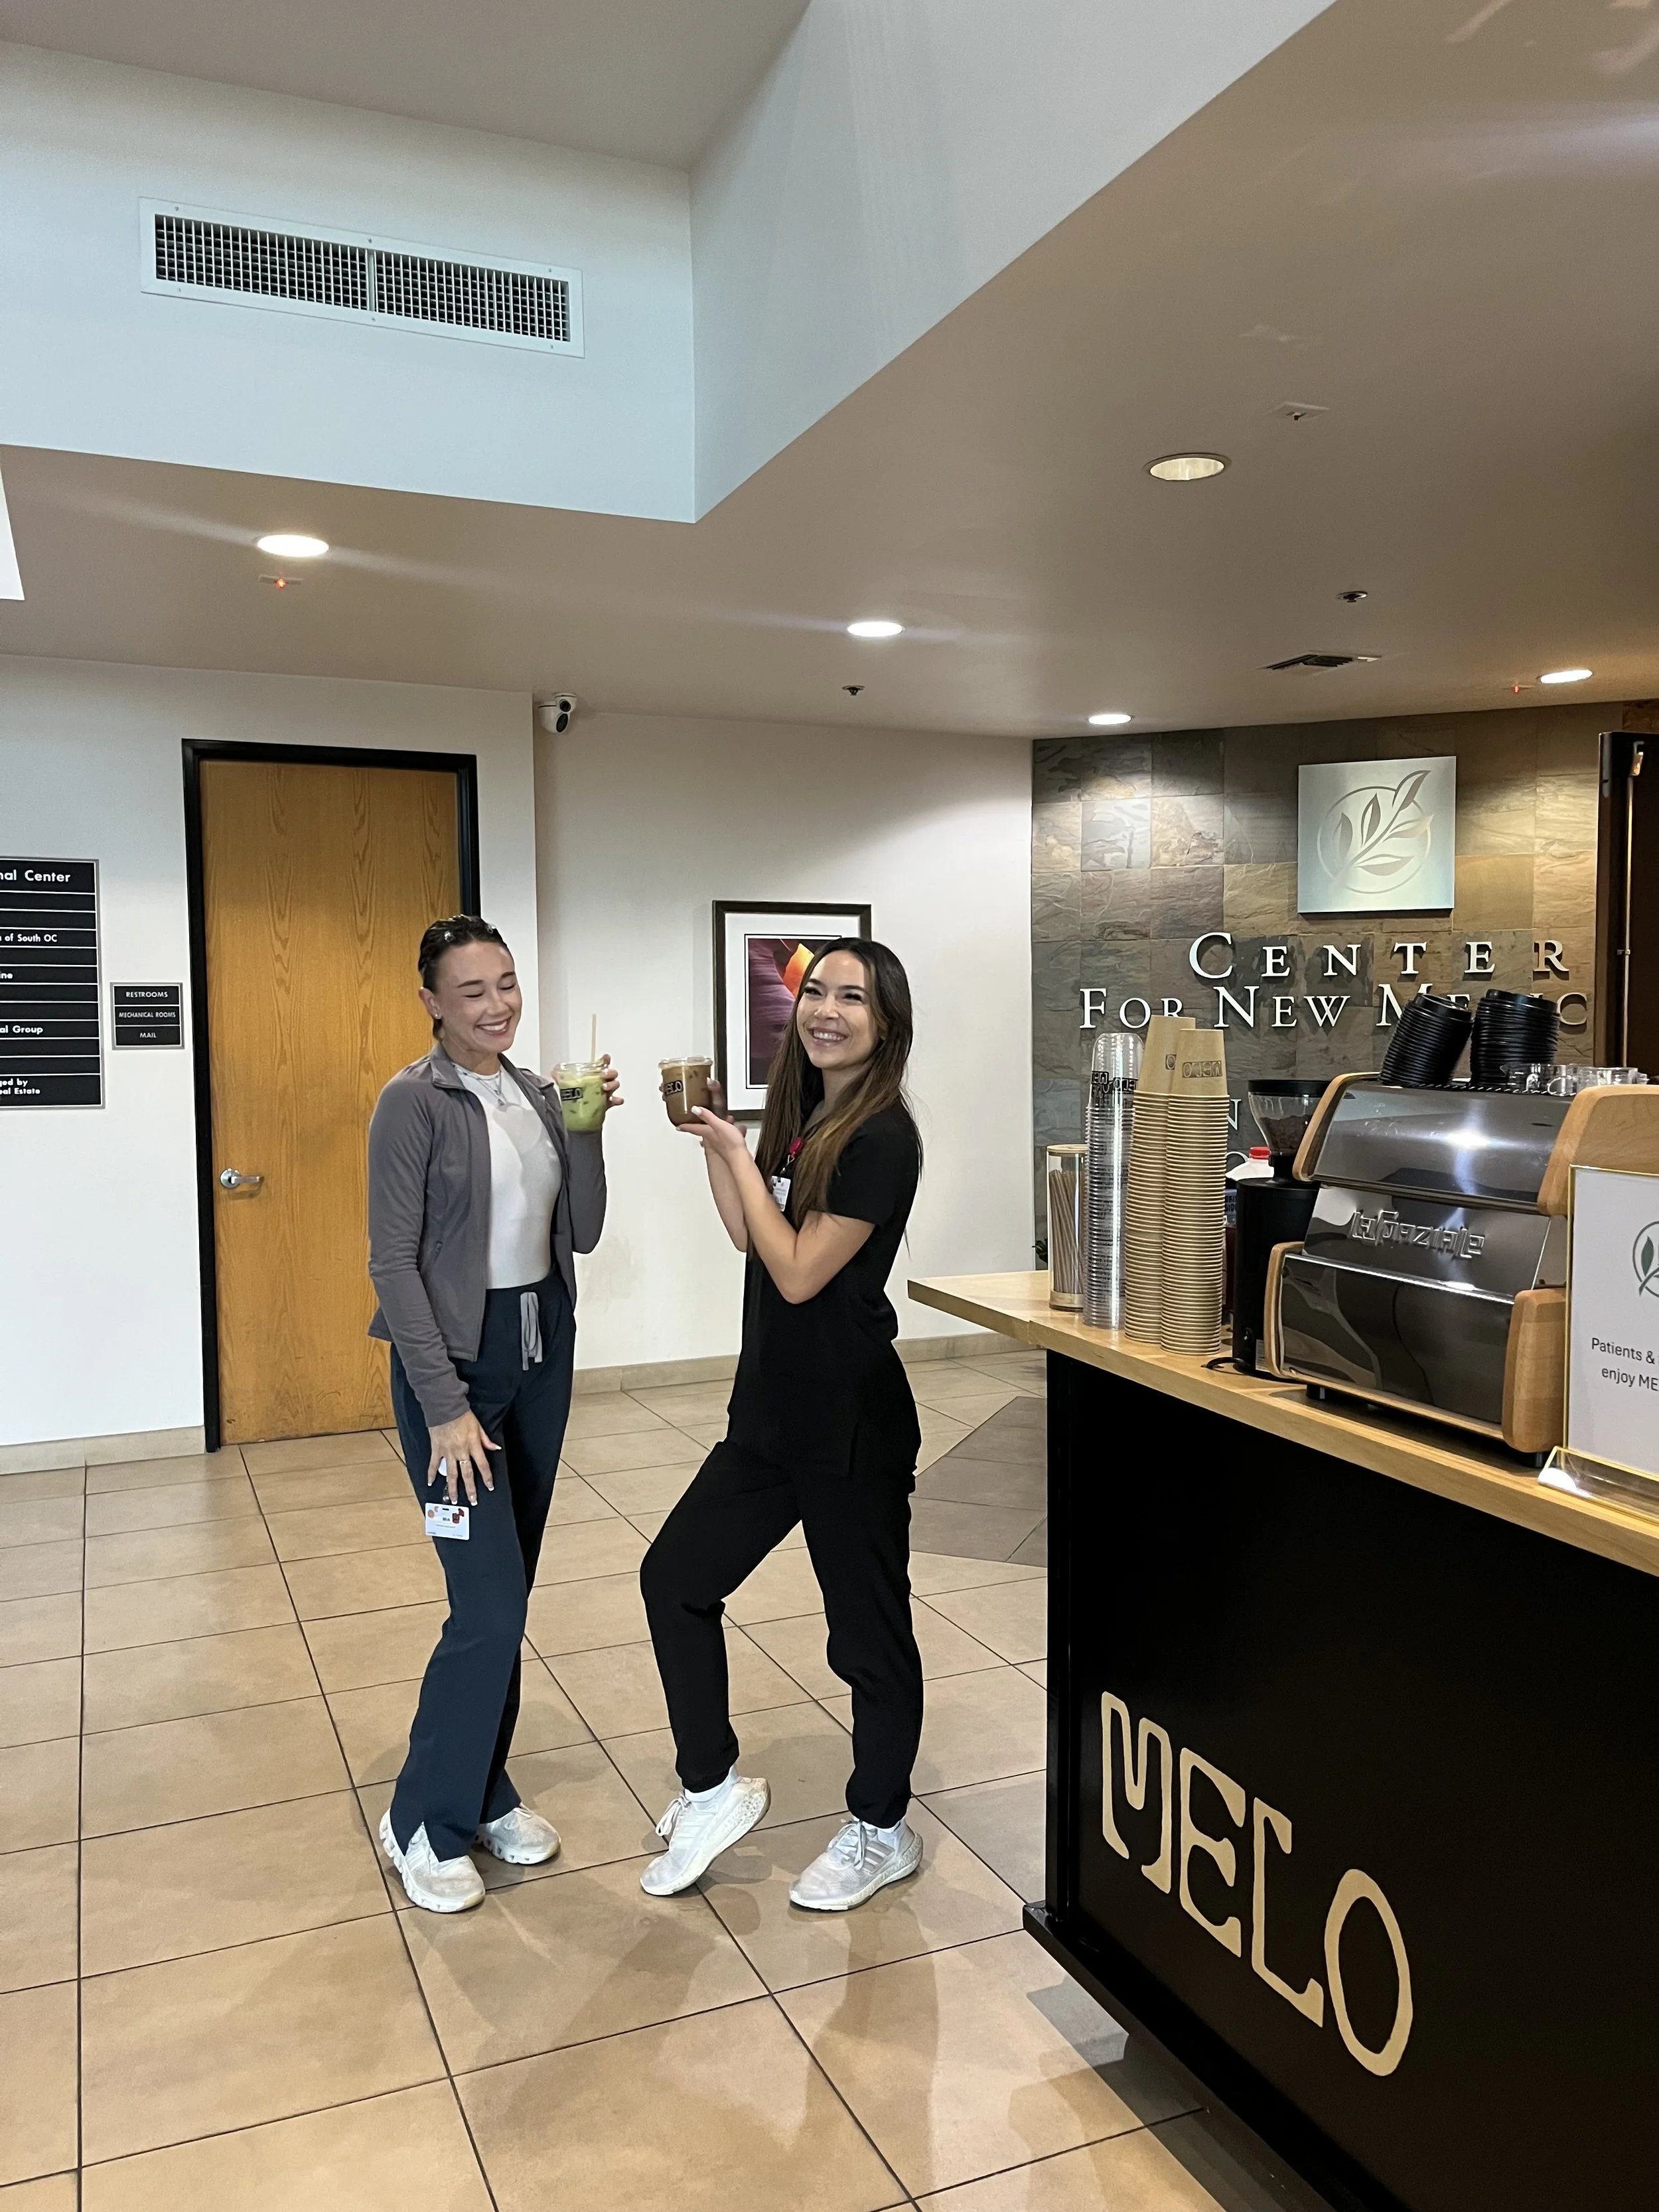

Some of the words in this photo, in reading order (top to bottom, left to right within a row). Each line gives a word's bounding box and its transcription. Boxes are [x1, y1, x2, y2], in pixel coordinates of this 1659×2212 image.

[25, 869, 71, 882] Center
[4, 932, 14, 942] of
[17, 933, 41, 942] South
[43, 933, 58, 942] OC
[1189, 932, 1570, 979] CENTER
[1213, 986, 1350, 1028] NEW
[12, 1025, 44, 1035] Group
[17, 1078, 29, 1088] by
[664, 1080, 683, 1095] ELO
[1592, 1337, 1642, 1361] Patients
[1646, 1351, 1656, 1364] &
[1601, 1368, 1635, 1388] enjoy
[1638, 1374, 1659, 1392] ME
[1101, 1690, 1413, 2077] MELO
